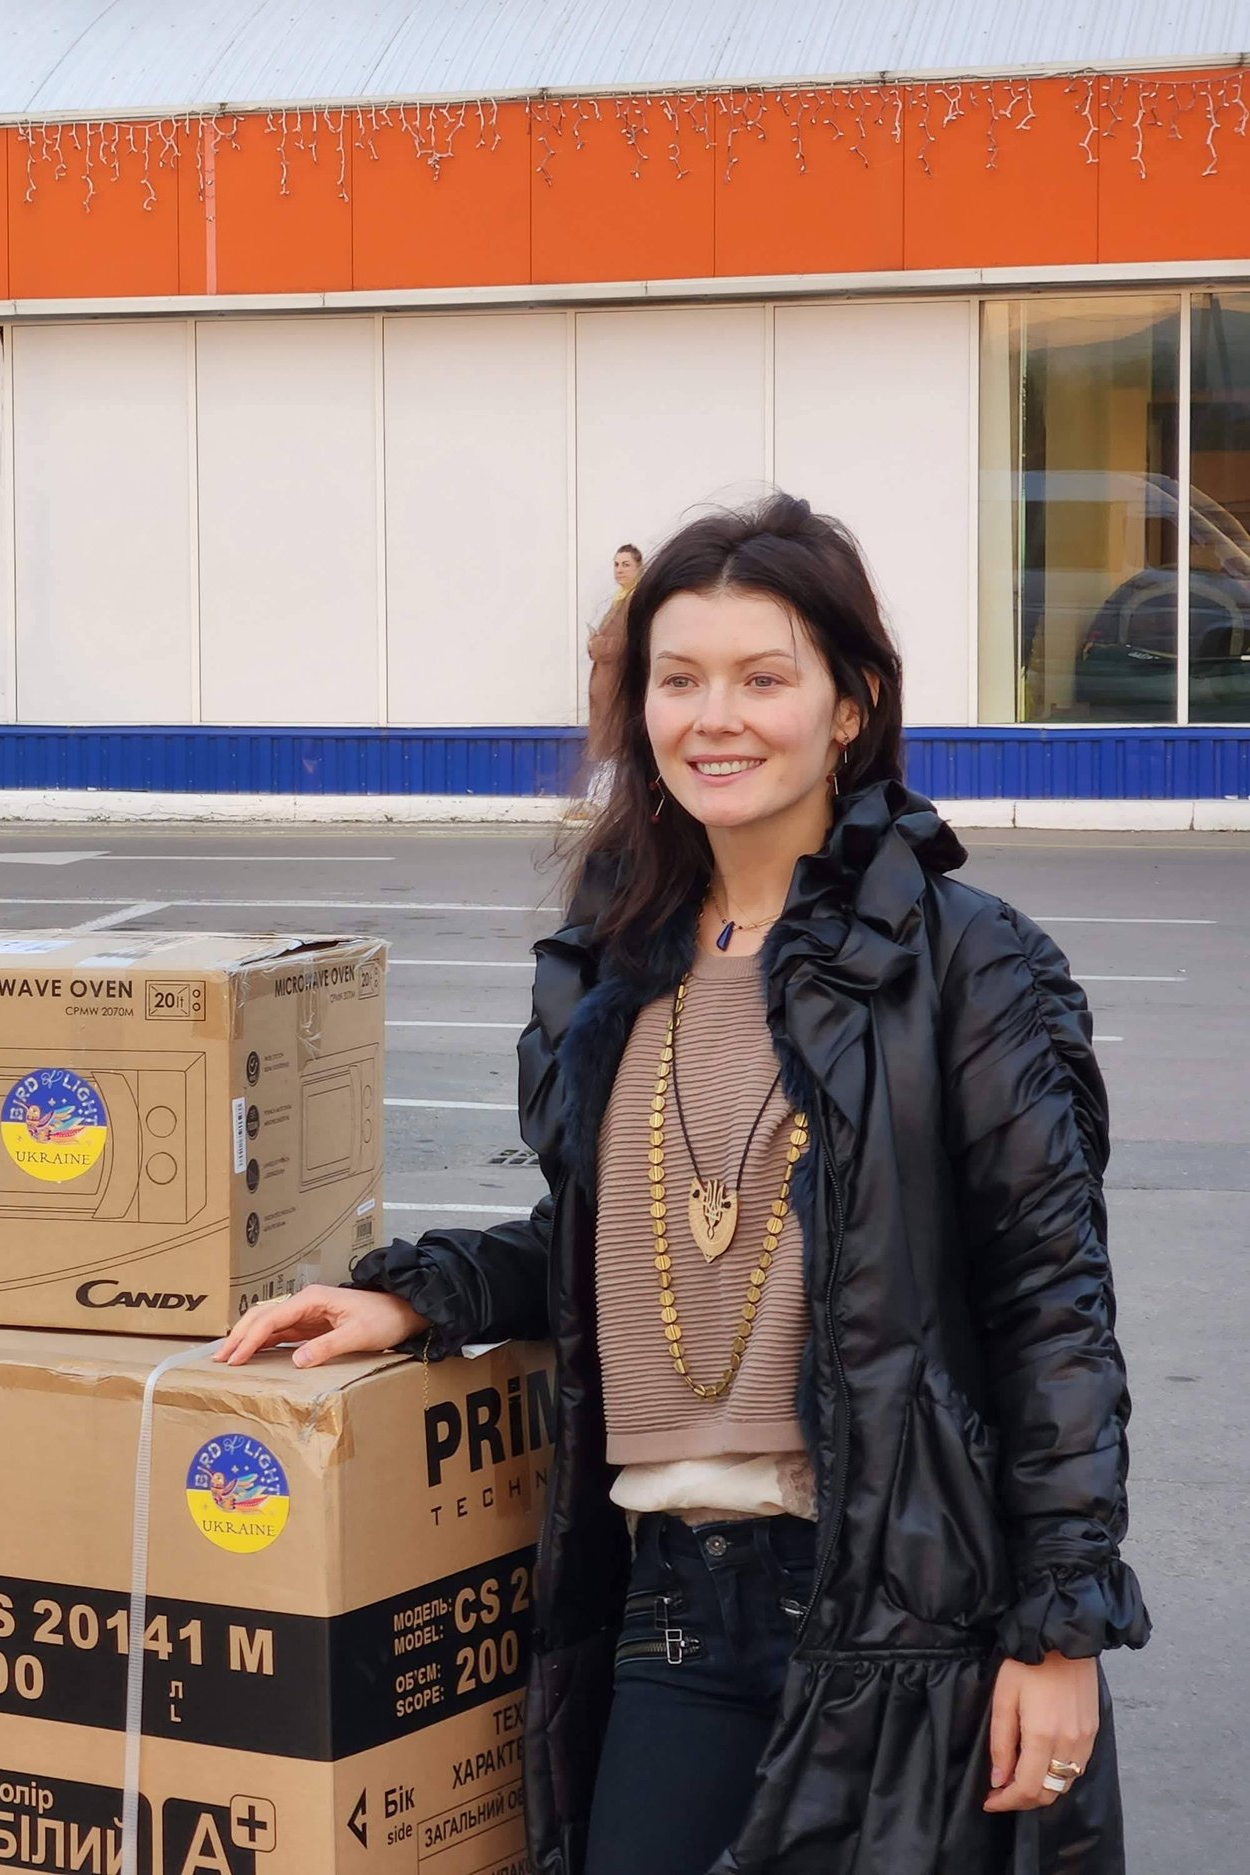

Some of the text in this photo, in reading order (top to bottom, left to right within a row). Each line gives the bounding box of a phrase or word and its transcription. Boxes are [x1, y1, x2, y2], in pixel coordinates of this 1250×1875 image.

[70, 979, 133, 999] OVEN
[274, 969, 329, 998] MICROWAVE
[331, 964, 355, 985] OVEN
[65, 1006, 99, 1016] CPMW
[62, 1073, 98, 1127] LIGHT
[15, 1151, 91, 1166] UKRAINE
[75, 1279, 209, 1311] CANDY
[244, 1440, 280, 1496] LIGHT
[202, 1520, 277, 1537] UKRAINE
[394, 1597, 452, 1632] МОДЕЛЬ:
[454, 1566, 539, 1634] CS 2
[32, 1599, 204, 1666] 20141
[228, 1624, 275, 1676] M
[394, 1624, 444, 1656] MODEL:
[456, 1629, 519, 1695] 200
[169, 1680, 184, 1699] Л
[395, 1686, 444, 1718] SCOPE:
[170, 1704, 183, 1723] L
[384, 1785, 416, 1819] Бік
[387, 1822, 413, 1846] side
[424, 1793, 505, 1848] ЗАГАЛЬНИЙ
